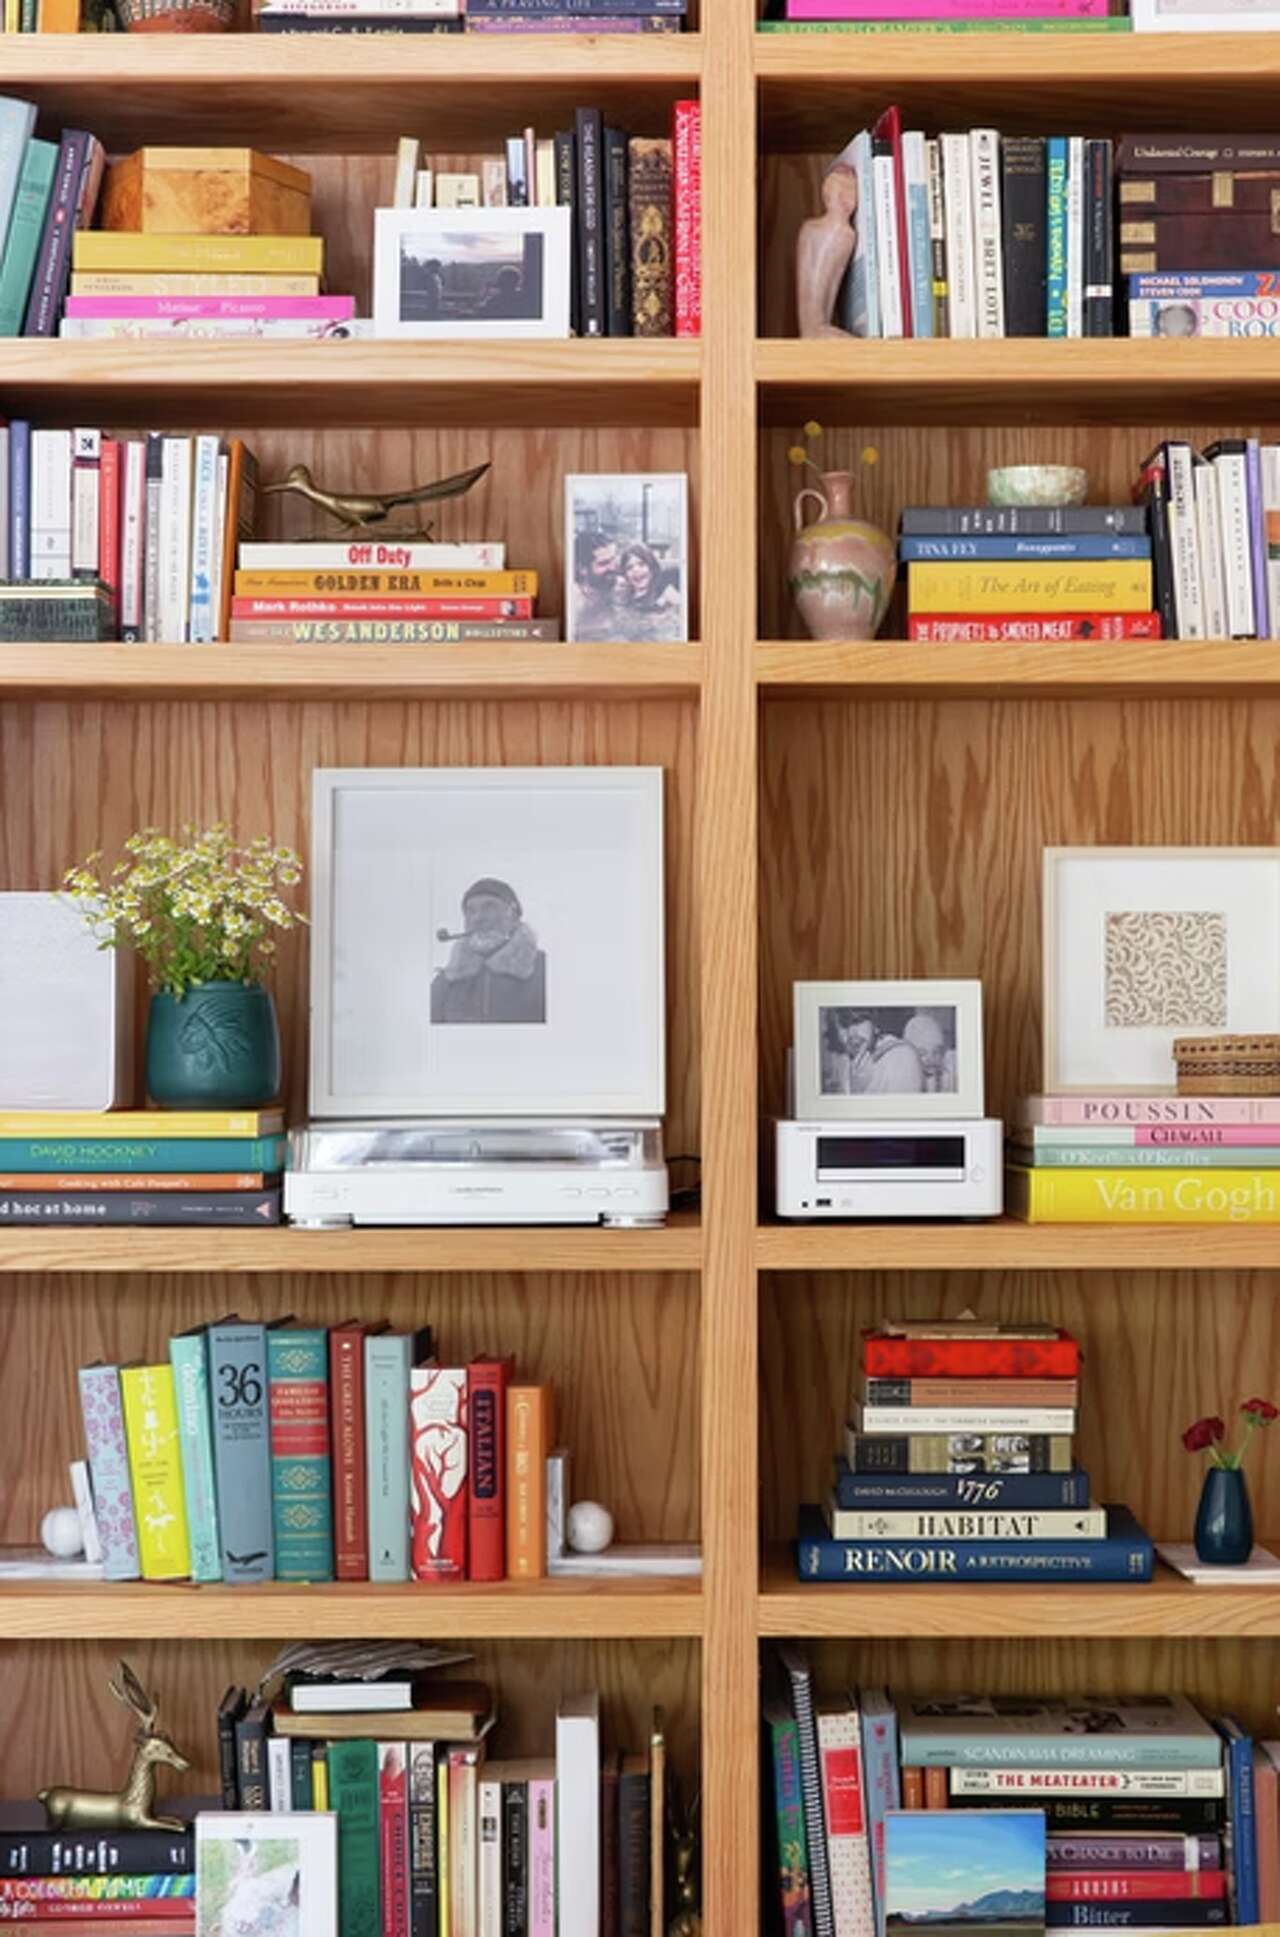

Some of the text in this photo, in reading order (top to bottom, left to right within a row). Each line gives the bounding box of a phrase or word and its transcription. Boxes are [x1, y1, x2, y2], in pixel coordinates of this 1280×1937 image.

[348, 545, 411, 567] Off Duty
[313, 575, 381, 591] GOLDEN
[388, 575, 422, 591] ERA
[980, 575, 1008, 593] The
[1012, 575, 1039, 594] Art
[1043, 575, 1061, 598] of
[1062, 576, 1117, 598] Eating
[252, 602, 337, 613] Mark Rothko
[292, 621, 342, 641] WES
[347, 621, 461, 641] ANDERSON
[1083, 1102, 1216, 1120] POUSSIN
[31, 1144, 158, 1158] DAVID HOCKNEY
[58, 1177, 99, 1190] Cooking
[101, 1177, 122, 1187] with
[12, 1202, 40, 1215] hoc
[44, 1203, 62, 1215] at
[64, 1202, 107, 1215] home
[1095, 1174, 1278, 1223] Van Gogh
[218, 1363, 263, 1408] 36
[342, 1355, 354, 1465] THE GREAT ALONE
[476, 1396, 494, 1491] ITALIAN
[853, 1486, 884, 1496] DAVID
[956, 1479, 1004, 1504] 1776
[916, 1515, 1041, 1536] HABITAT
[844, 1548, 1093, 1574] RENOIR A RETROSPECTIVE
[963, 1744, 1137, 1762] SCANDINAVIA DREAMING
[997, 1773, 1120, 1788] THE MEATEATER
[1055, 1804, 1100, 1819] BIBLE
[421, 1812, 435, 1869] EMPIRE
[1072, 1905, 1132, 1925] Bitter
